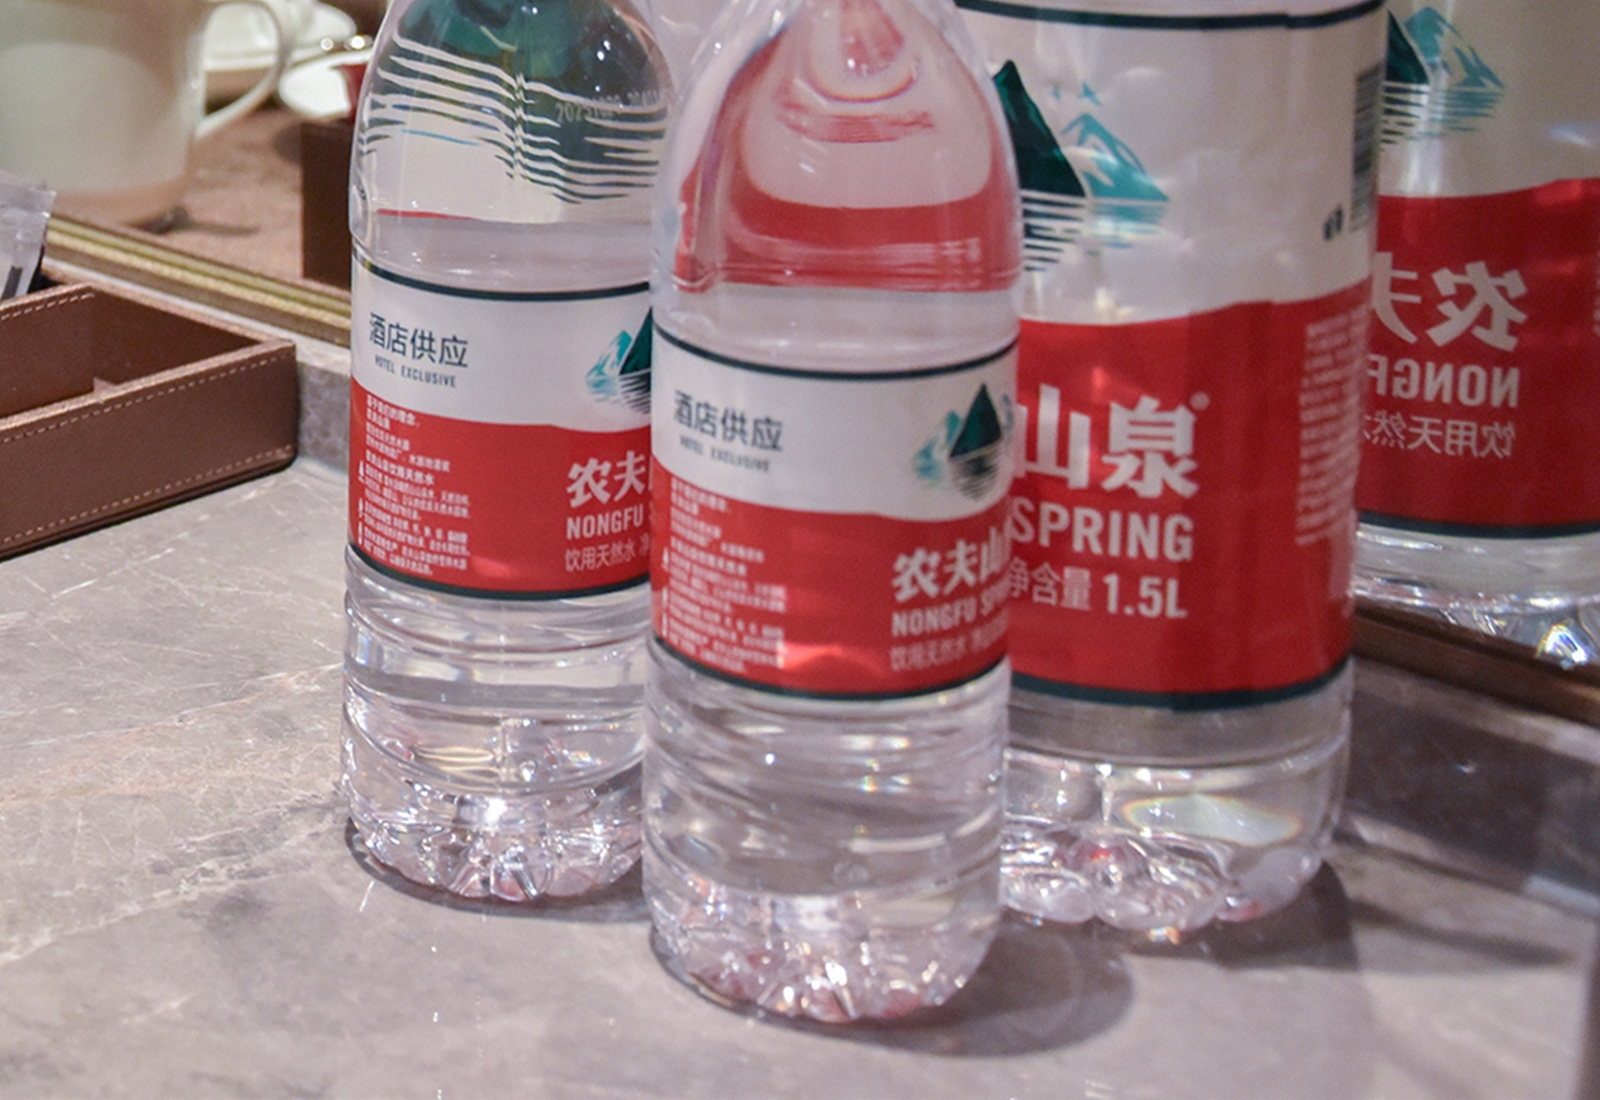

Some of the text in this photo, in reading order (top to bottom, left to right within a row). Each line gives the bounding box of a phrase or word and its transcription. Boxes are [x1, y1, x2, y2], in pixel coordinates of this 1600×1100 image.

[369, 311, 469, 369] 酒店供应
[374, 354, 457, 389] HOTEL EXCLUSIVE
[674, 389, 783, 452] 酒店供应
[1013, 382, 1200, 499] 山泉
[566, 450, 653, 508] 农夫
[566, 503, 644, 540] NONGFU
[1006, 496, 1194, 563] SPRING
[1102, 571, 1188, 620] 1.5L
